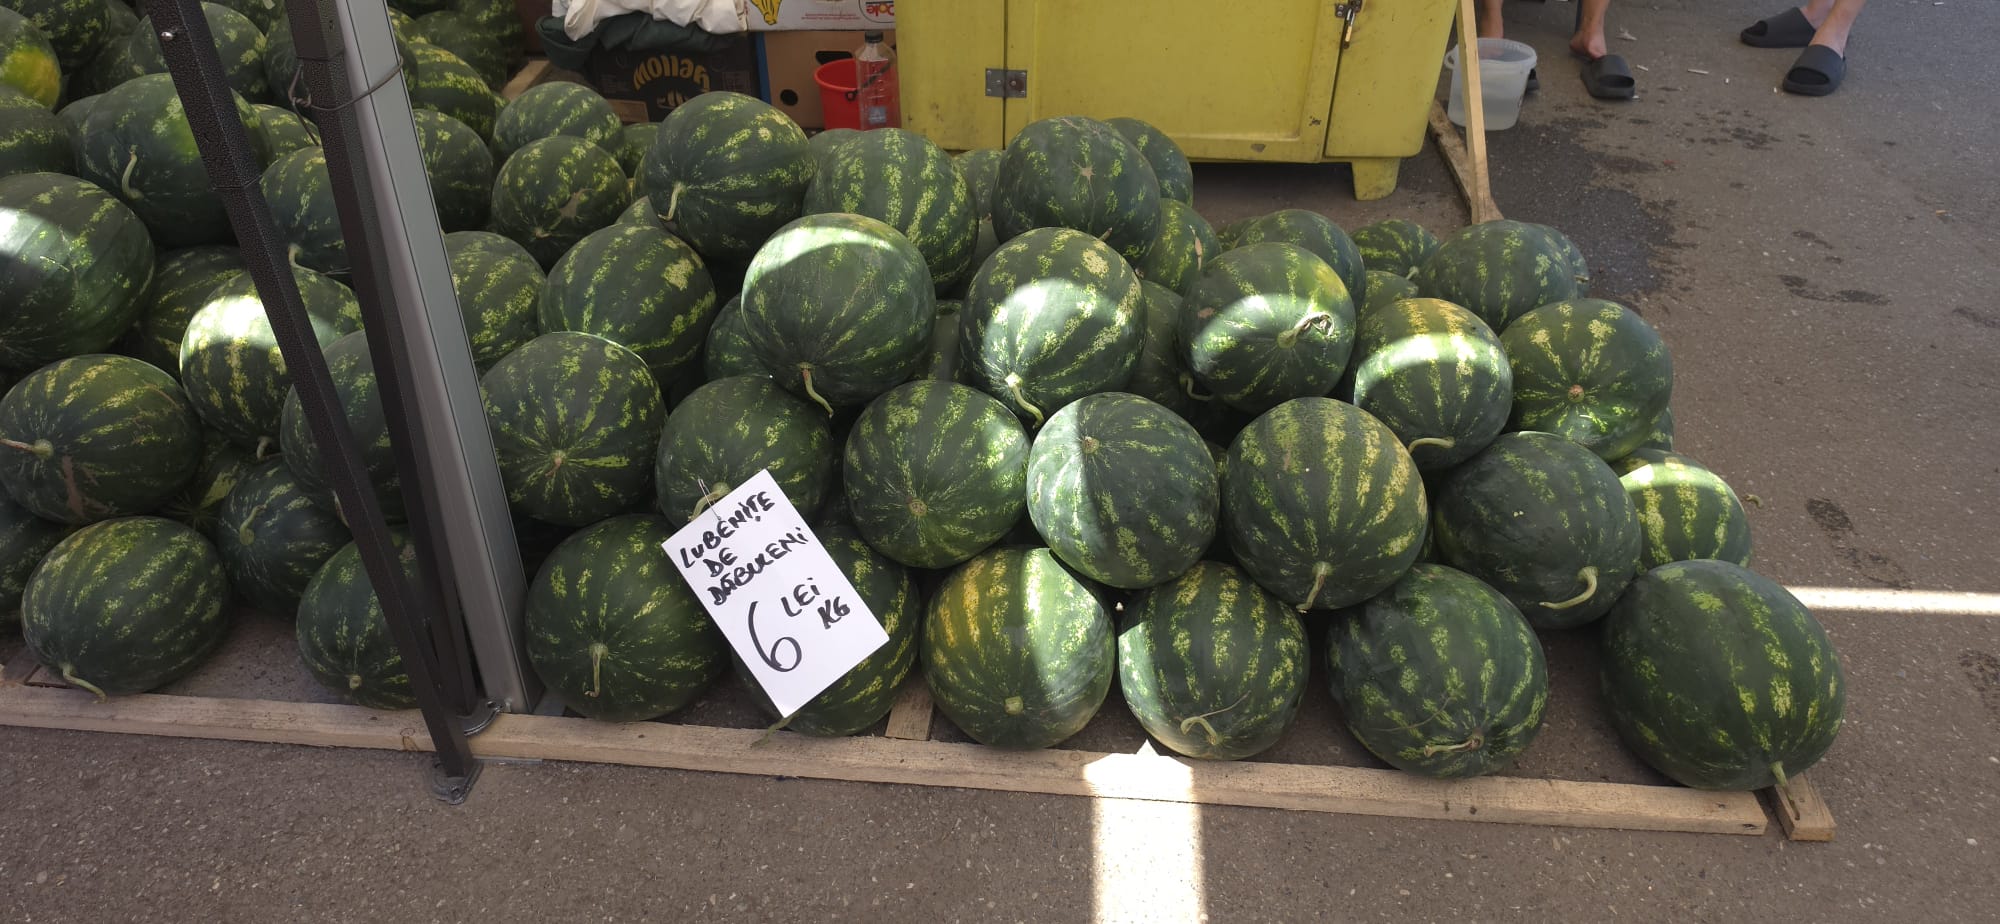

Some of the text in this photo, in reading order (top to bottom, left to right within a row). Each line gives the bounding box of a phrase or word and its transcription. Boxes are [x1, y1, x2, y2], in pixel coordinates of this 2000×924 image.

[703, 547, 738, 577] DE
[817, 596, 851, 630] KG
[748, 601, 803, 672] 6
